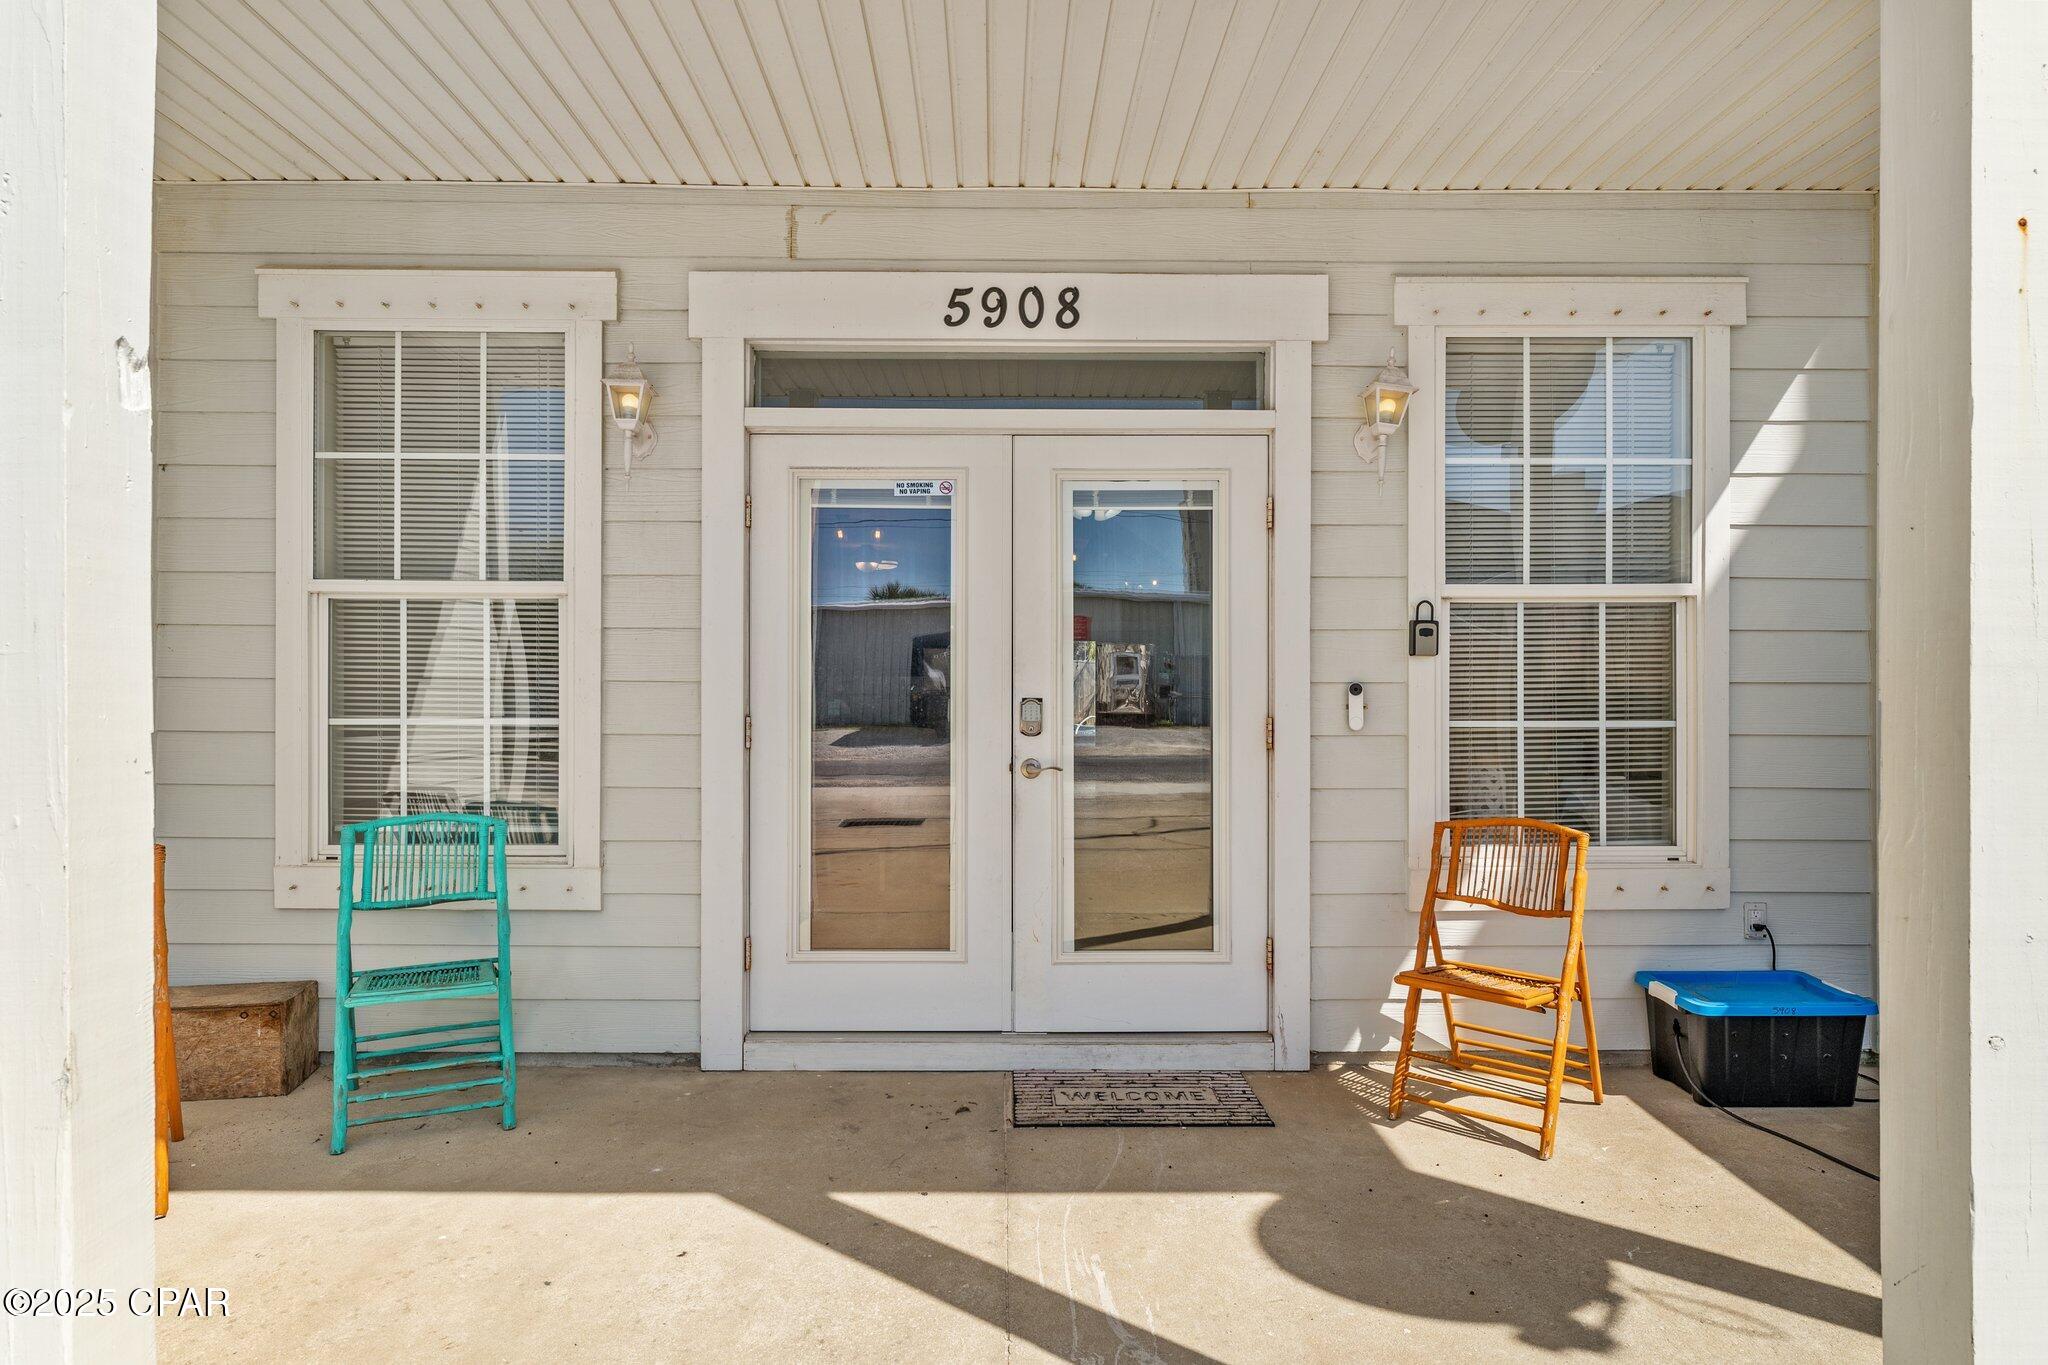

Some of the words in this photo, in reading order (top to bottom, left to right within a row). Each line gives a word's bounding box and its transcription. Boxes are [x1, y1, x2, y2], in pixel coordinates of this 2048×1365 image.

[943, 285, 1080, 329] 5908
[1772, 1006, 1797, 1015] 5908
[1061, 1090, 1206, 1102] WELCOME
